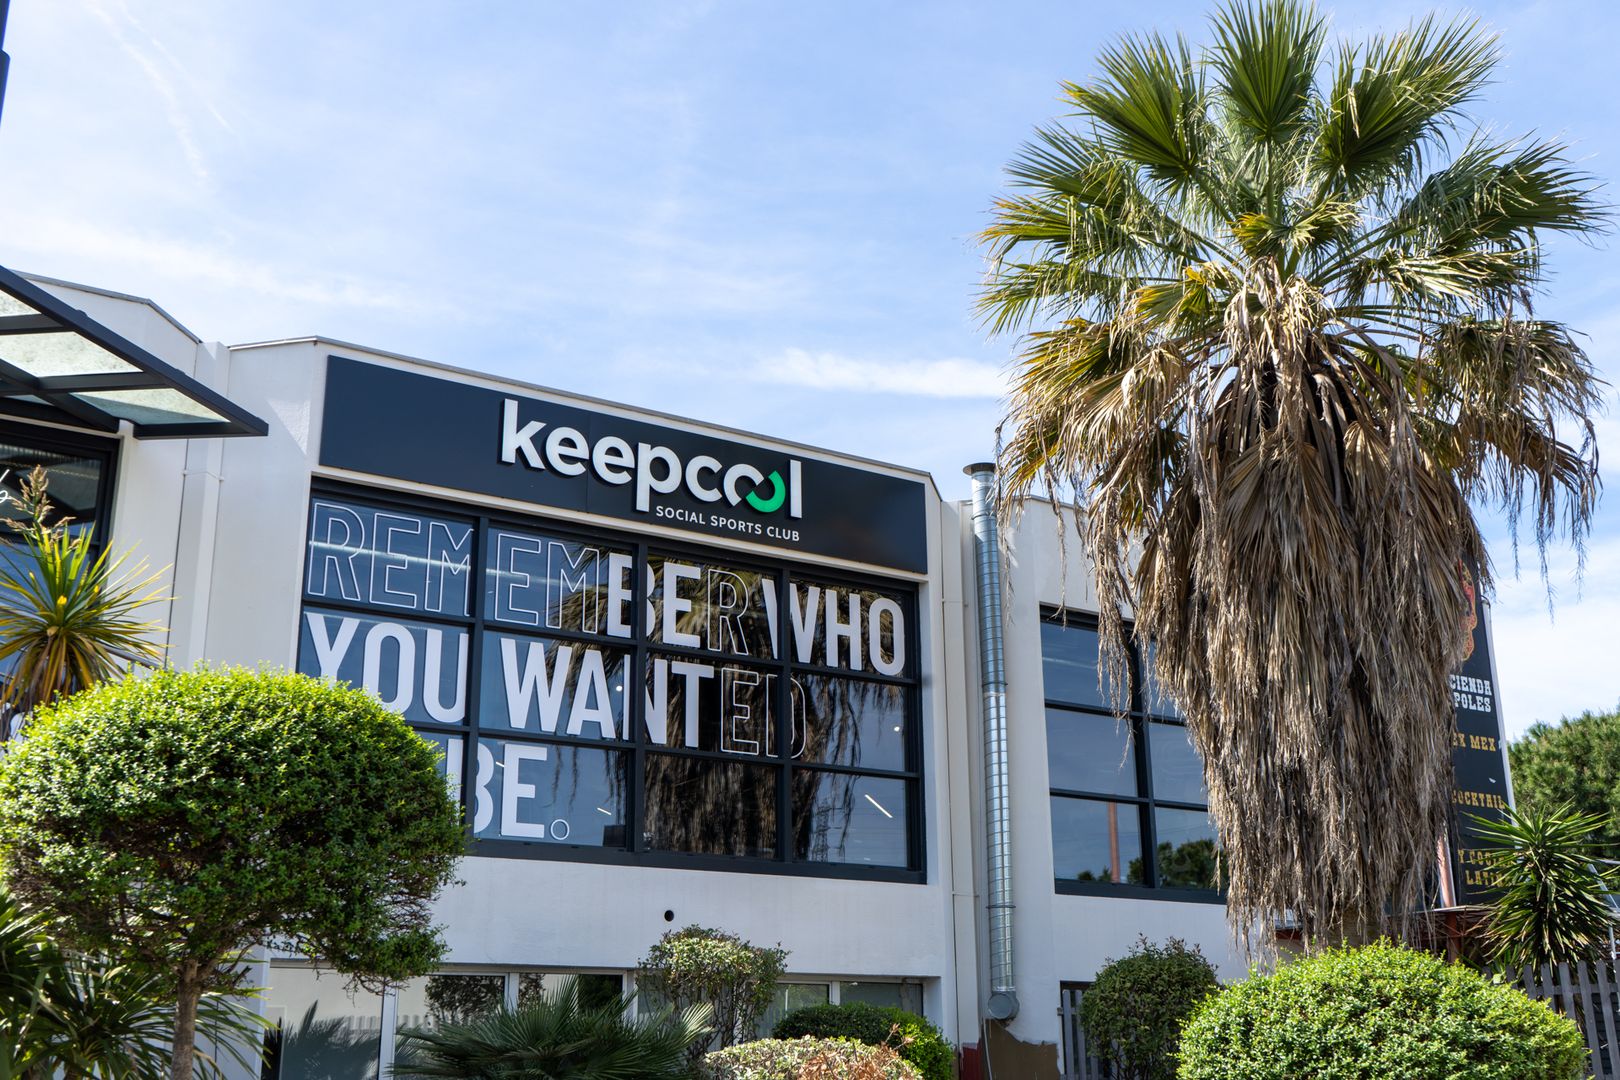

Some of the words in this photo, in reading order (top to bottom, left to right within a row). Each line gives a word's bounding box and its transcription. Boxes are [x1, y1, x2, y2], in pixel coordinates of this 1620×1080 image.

[501, 398, 803, 519] keepcool
[655, 505, 706, 525] SOCIAL
[710, 515, 762, 535] SPORTS
[766, 526, 800, 542] CLUB
[307, 502, 749, 656] REMEMBER
[761, 577, 906, 676] WHO
[306, 611, 470, 723] YOU
[500, 637, 807, 759] WANTED
[1469, 734, 1496, 752] MEX
